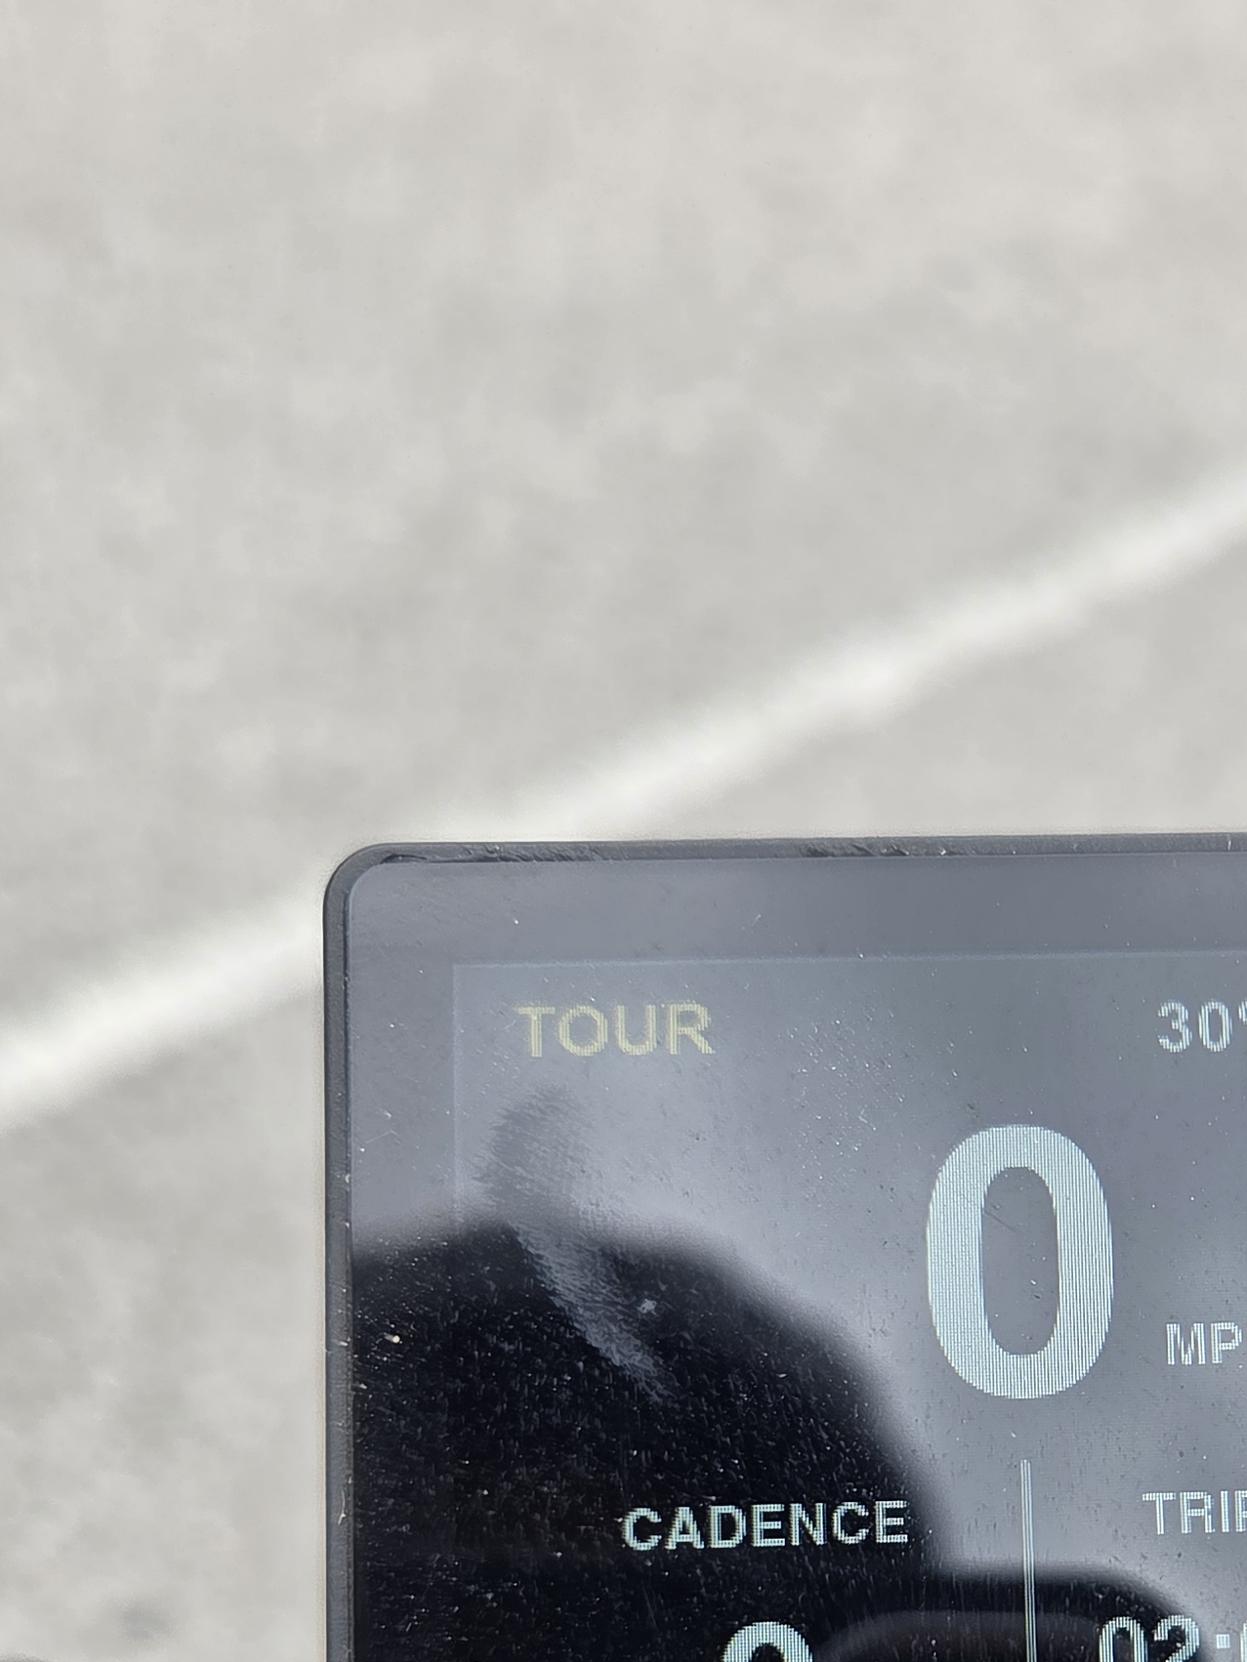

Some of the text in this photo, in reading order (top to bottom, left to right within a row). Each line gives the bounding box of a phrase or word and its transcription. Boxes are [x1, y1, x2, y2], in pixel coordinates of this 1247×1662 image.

[519, 1002, 716, 1059] TOUR
[926, 1123, 1115, 1400] 0
[622, 1499, 909, 1552] CADENCE
